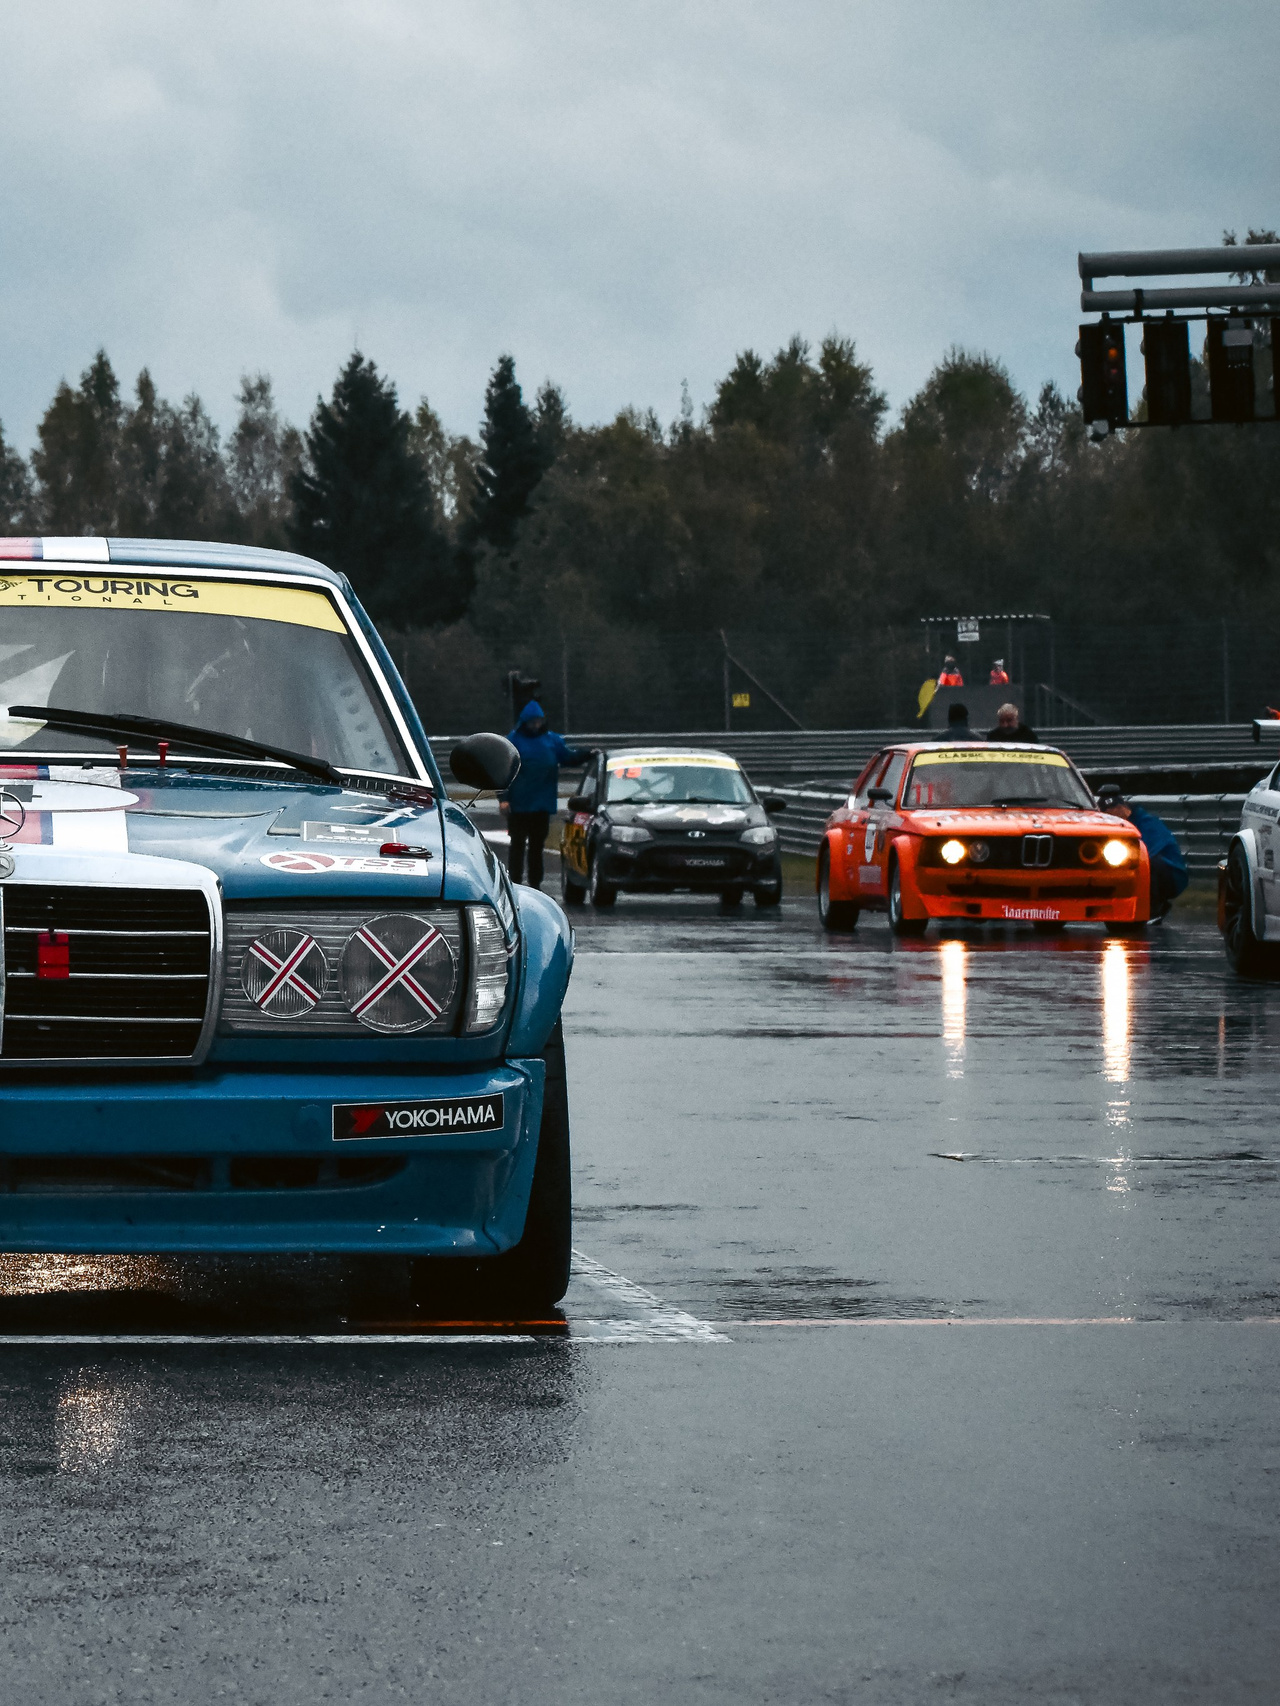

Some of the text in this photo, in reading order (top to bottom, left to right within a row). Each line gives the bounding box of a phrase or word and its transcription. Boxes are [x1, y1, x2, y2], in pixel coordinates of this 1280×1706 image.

[27, 578, 200, 599] TOURING
[339, 857, 417, 869] TSS
[384, 1104, 496, 1129] YOKOHAMA
